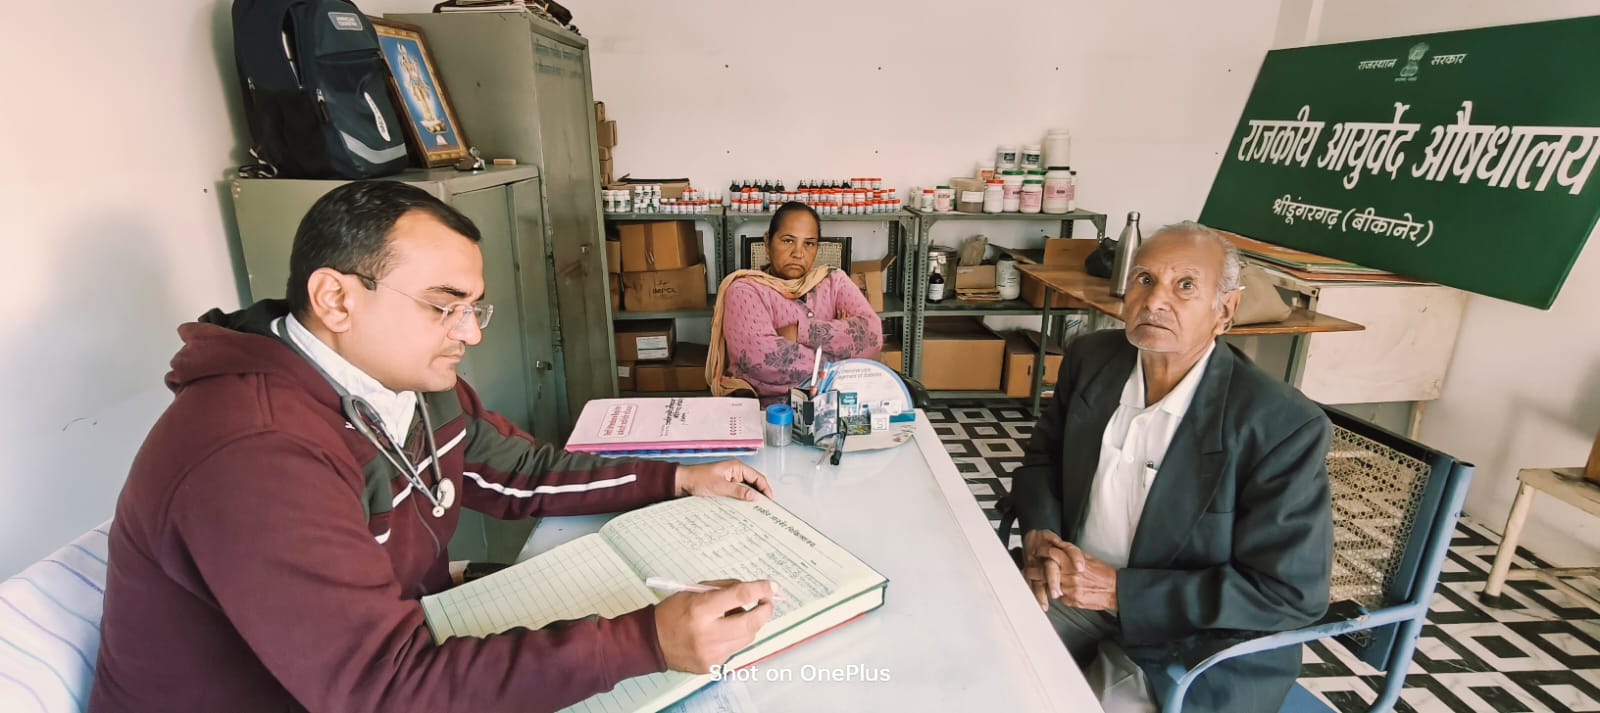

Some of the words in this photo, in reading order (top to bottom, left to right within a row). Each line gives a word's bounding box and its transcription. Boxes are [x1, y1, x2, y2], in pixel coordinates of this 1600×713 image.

[1358, 58, 1398, 71] राजस्थान
[1431, 53, 1468, 66] सरकार
[1237, 104, 1326, 168] राजकीय
[1317, 101, 1422, 190] आयुर्वेद
[1411, 100, 1600, 195] औषधालय
[1272, 194, 1342, 229] श्रीडूंगरगढ़
[1342, 207, 1434, 247] (बीकानेर)
